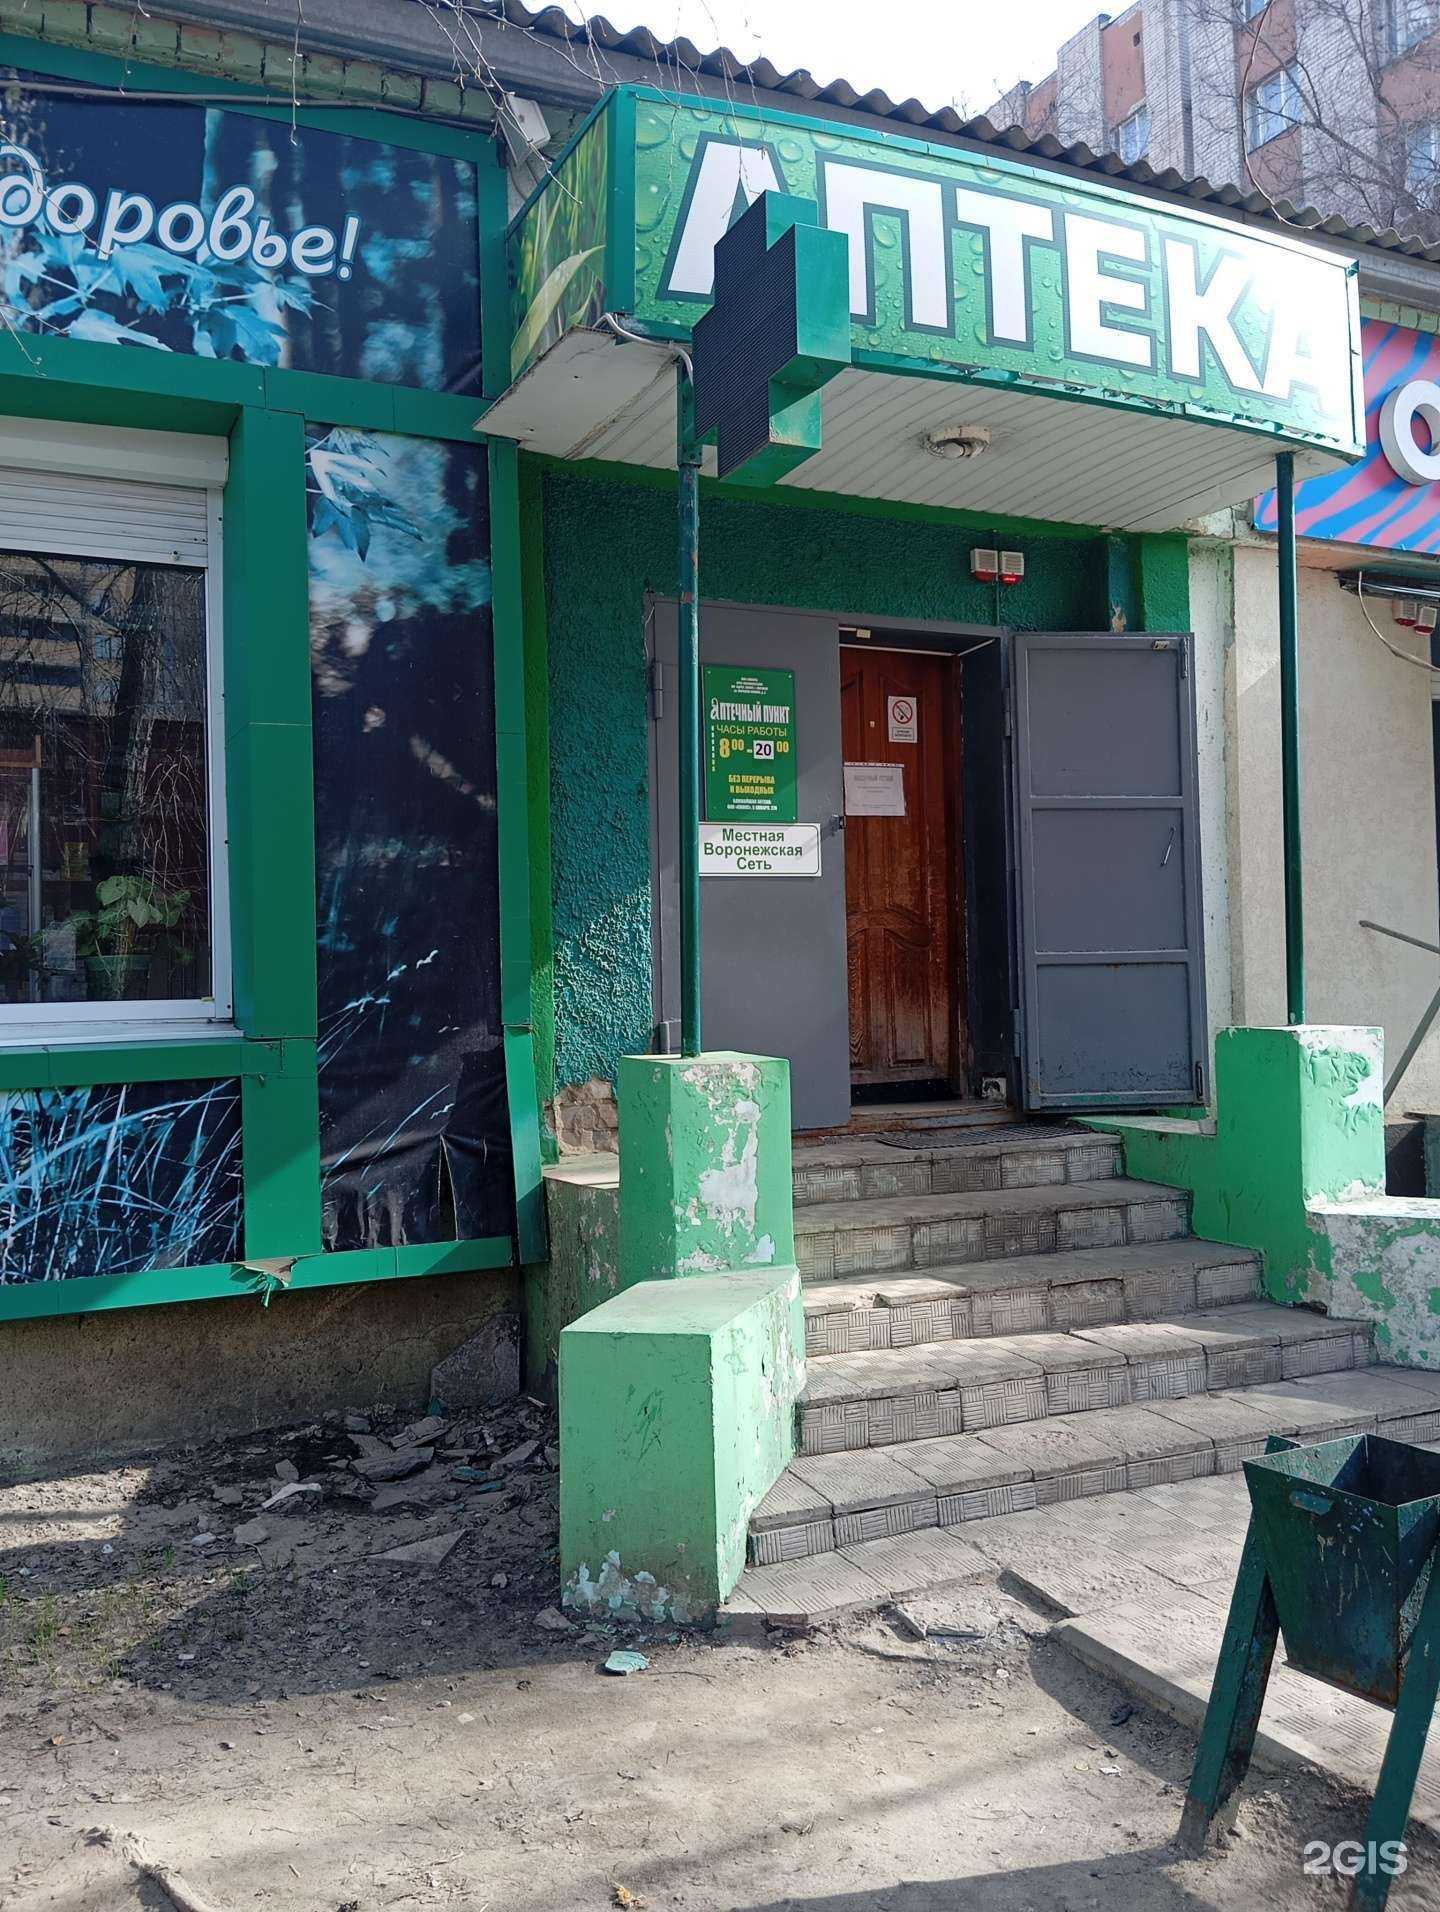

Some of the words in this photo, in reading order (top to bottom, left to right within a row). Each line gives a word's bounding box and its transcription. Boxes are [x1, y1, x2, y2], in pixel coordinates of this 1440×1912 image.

[657, 131, 1345, 430] АПТЕКА
[716, 724, 745, 733] ЧАСЫ
[747, 726, 787, 737] РАБОТЫ
[755, 743, 772, 756] 20
[728, 774, 741, 783] БЕЗ
[741, 775, 775, 785] ПЕРЕРЫВА
[735, 785, 774, 796] ВЫХОДНЫХ
[722, 828, 785, 842] Местная
[704, 842, 803, 859] Воронежская
[736, 857, 772, 870] Сеть
